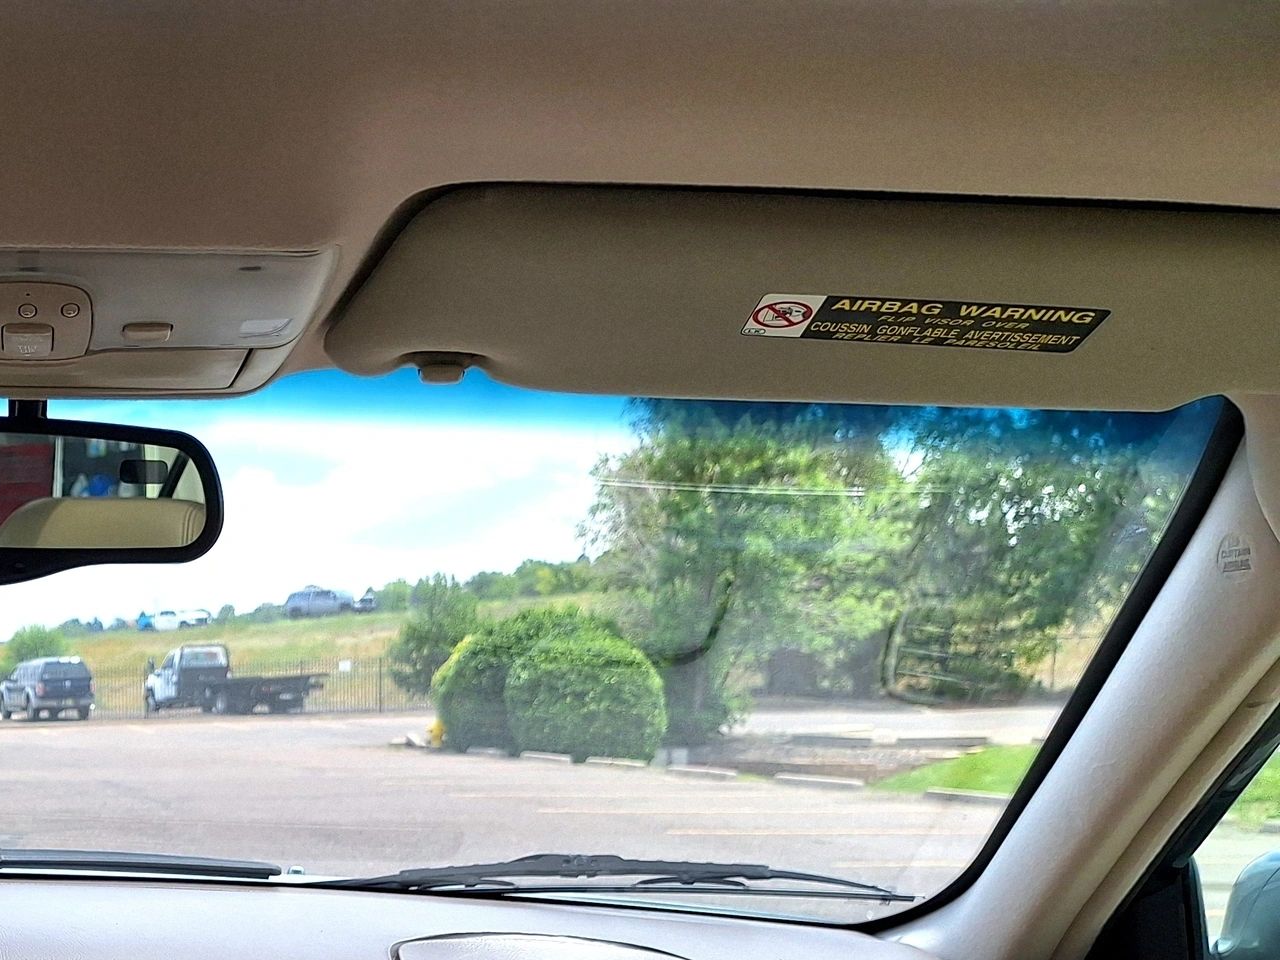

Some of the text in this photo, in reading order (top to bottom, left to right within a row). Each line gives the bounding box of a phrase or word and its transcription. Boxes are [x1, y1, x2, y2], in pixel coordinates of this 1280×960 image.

[831, 299, 1096, 324] AIRBAG WARNING
[810, 322, 1080, 345] COUSSIN GONFLABLE AVERTISSEMENT
[924, 318, 975, 326] VISOR
[981, 321, 1030, 329] OVER
[832, 333, 902, 342] REPLIER
[943, 339, 1041, 350] PARESOLEIL
